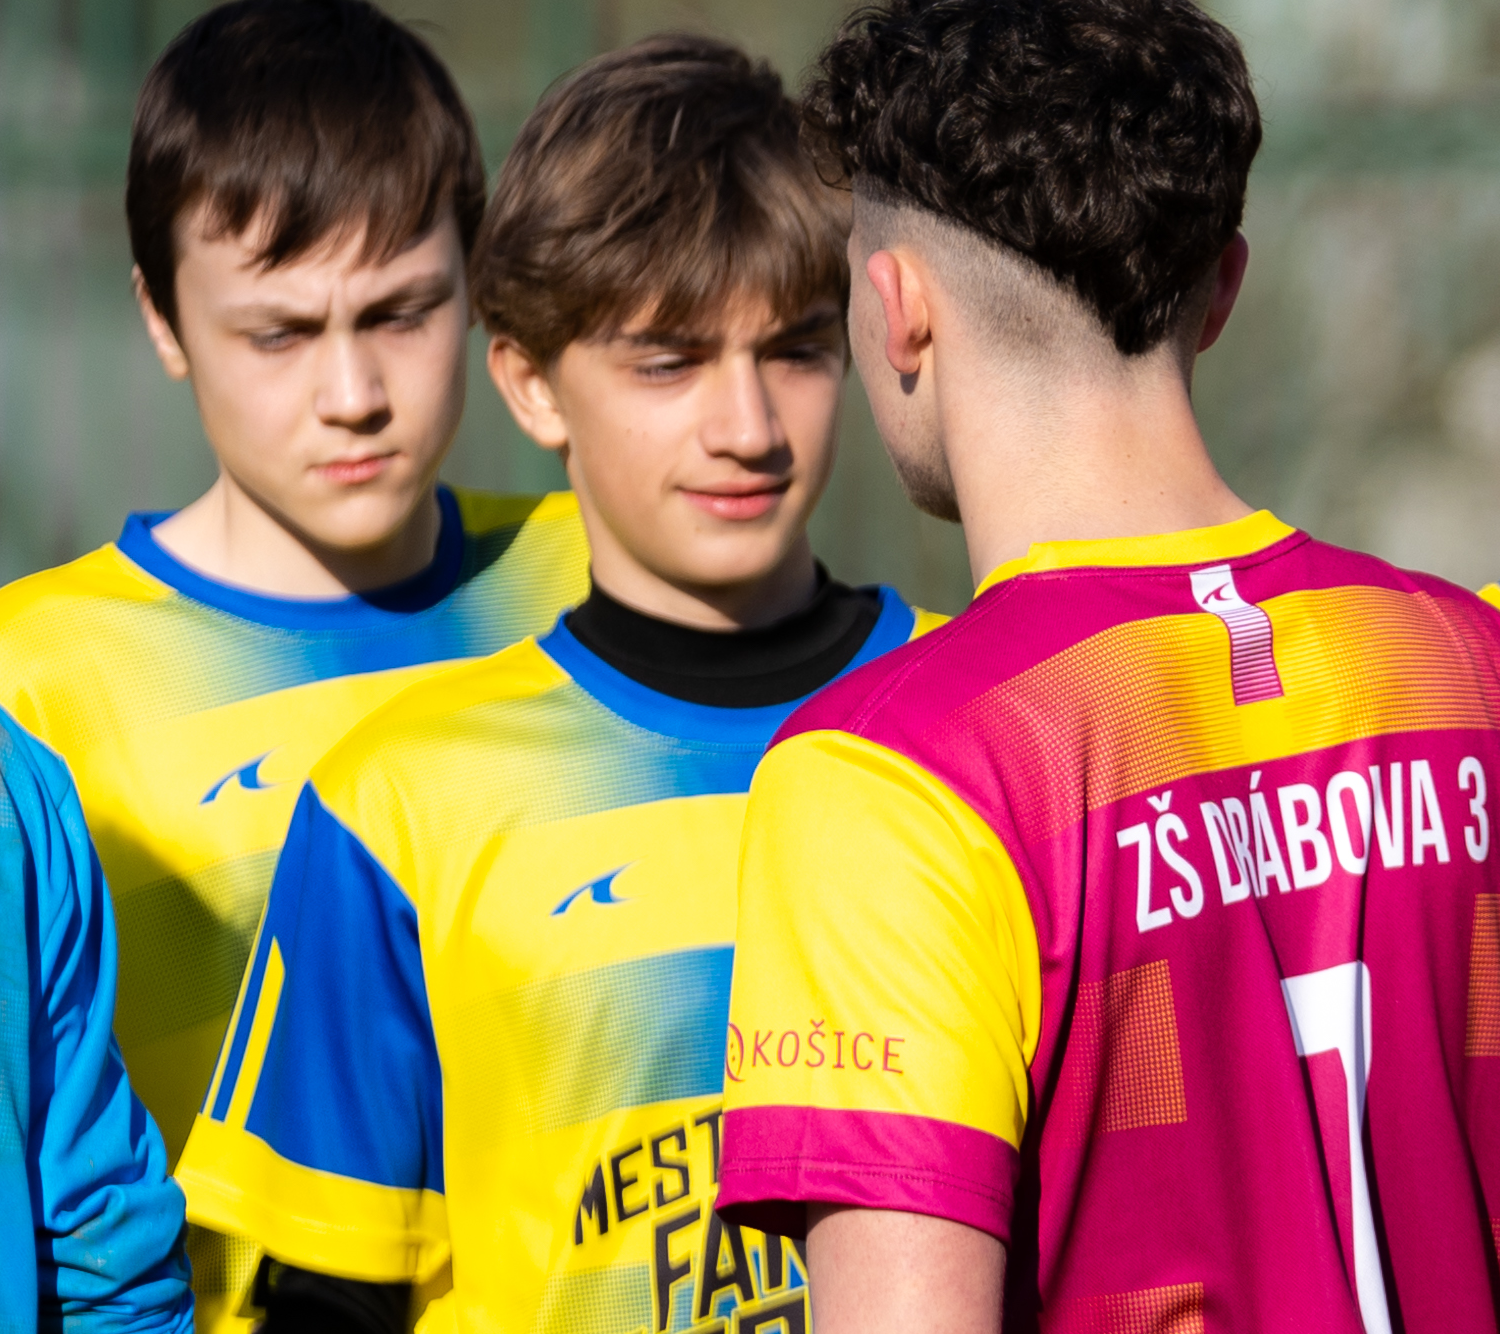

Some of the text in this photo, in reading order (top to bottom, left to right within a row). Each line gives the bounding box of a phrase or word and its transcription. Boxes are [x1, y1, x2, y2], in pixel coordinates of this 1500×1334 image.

[1116, 756, 1490, 934] ZŠ DRÁBOVA 3
[751, 1018, 905, 1075] KOŠICE
